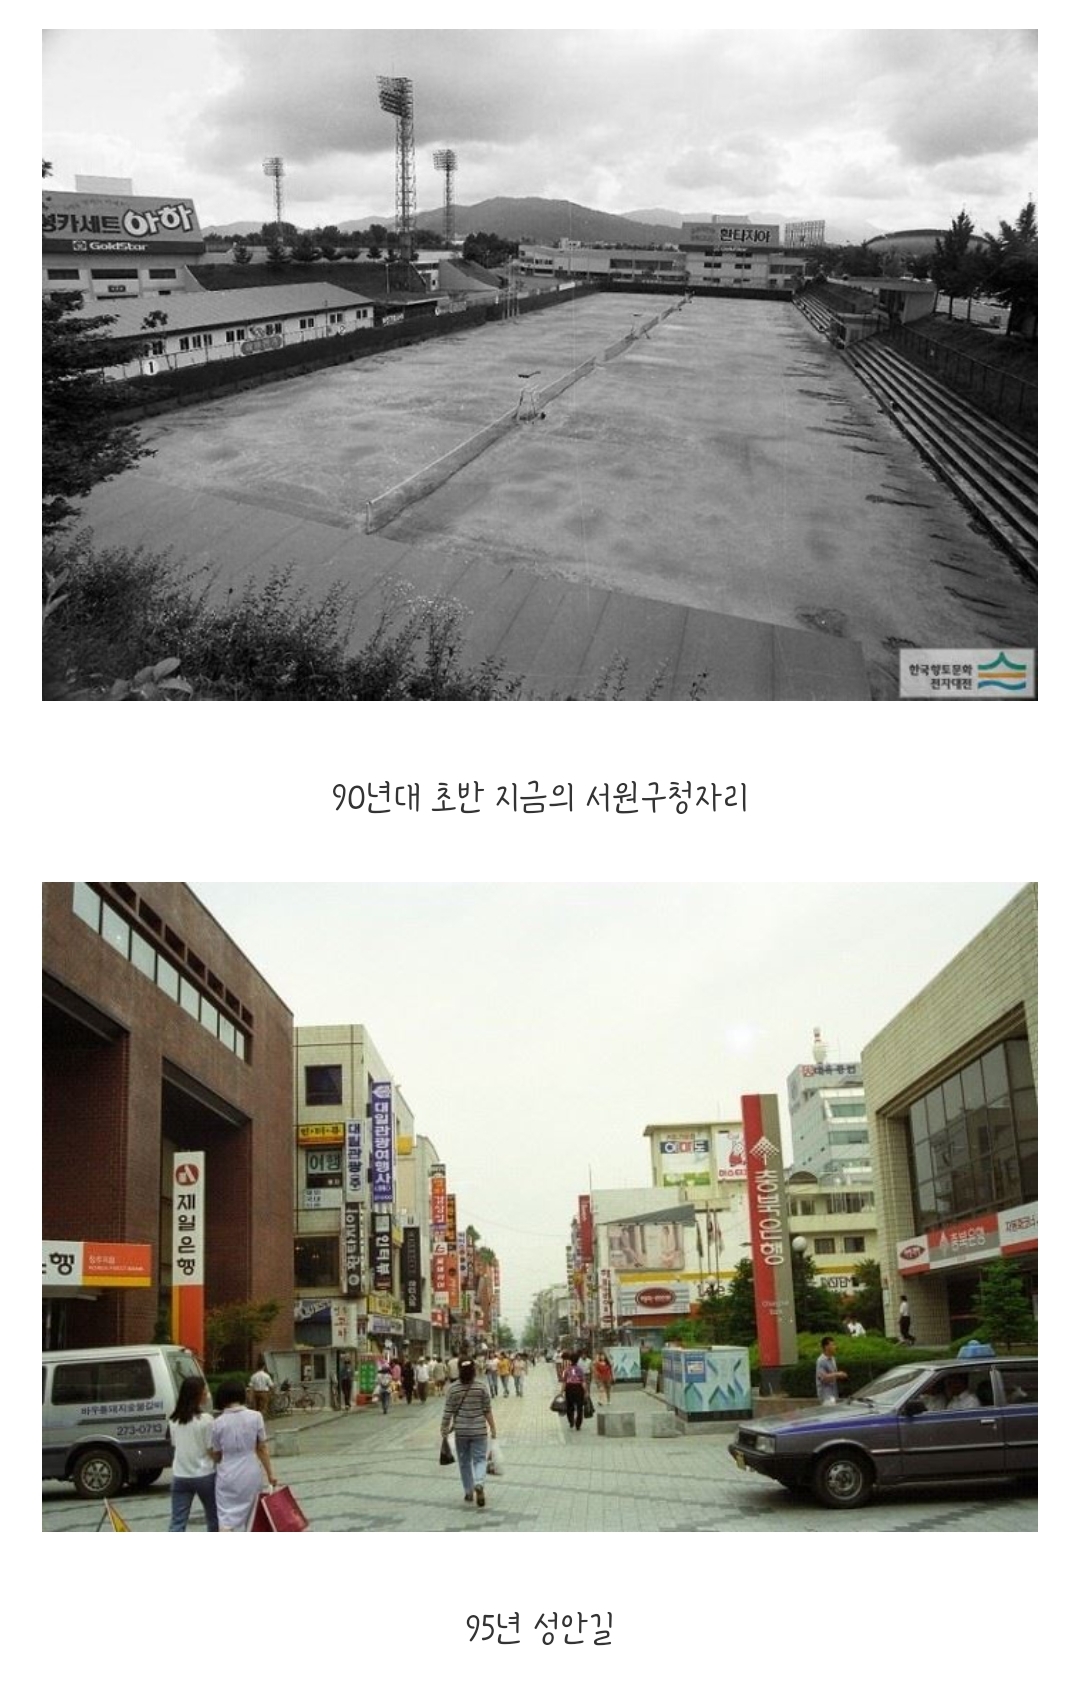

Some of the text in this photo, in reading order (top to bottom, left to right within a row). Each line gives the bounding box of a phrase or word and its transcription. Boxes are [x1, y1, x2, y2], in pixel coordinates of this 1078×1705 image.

[123, 202, 194, 238] 아하
[720, 227, 770, 243] 환타지아
[89, 242, 148, 251] GoldStar
[177, 1194, 196, 1276] 제일은행
[42, 1252, 75, 1276] 행
[116, 1423, 162, 1436] 273-0713
